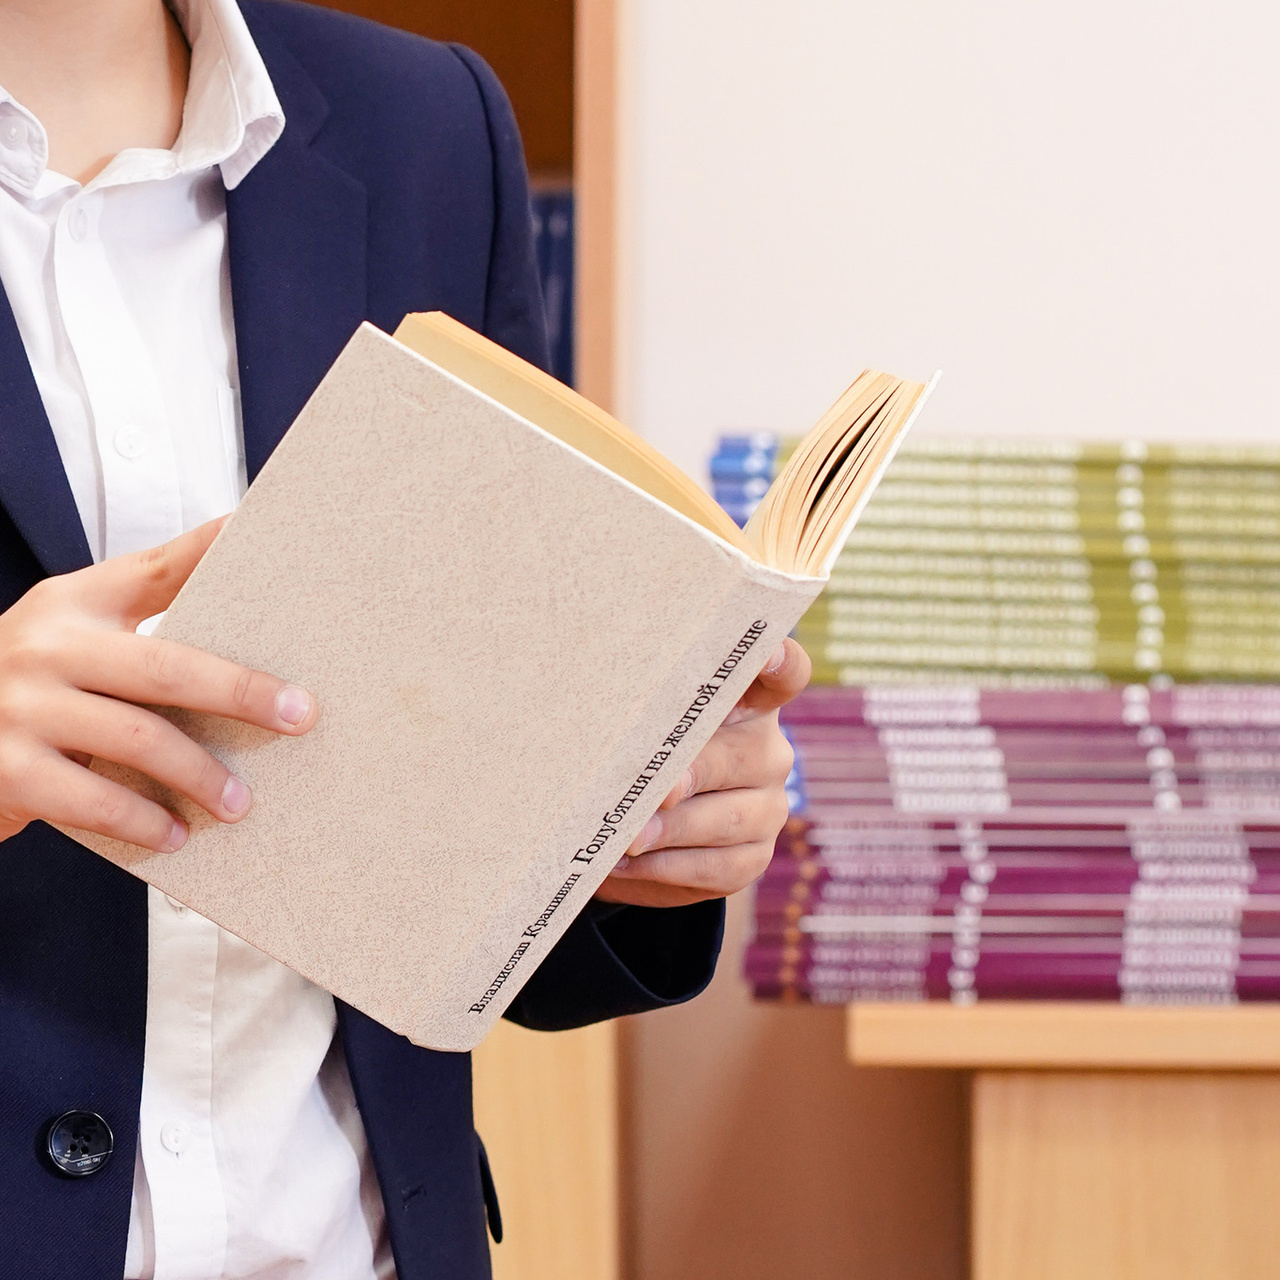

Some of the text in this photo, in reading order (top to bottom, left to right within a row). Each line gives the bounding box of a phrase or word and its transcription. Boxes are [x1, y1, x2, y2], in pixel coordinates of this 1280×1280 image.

[468, 618, 768, 1014] Владислав Крапивин Голубятня на желтой поляне
